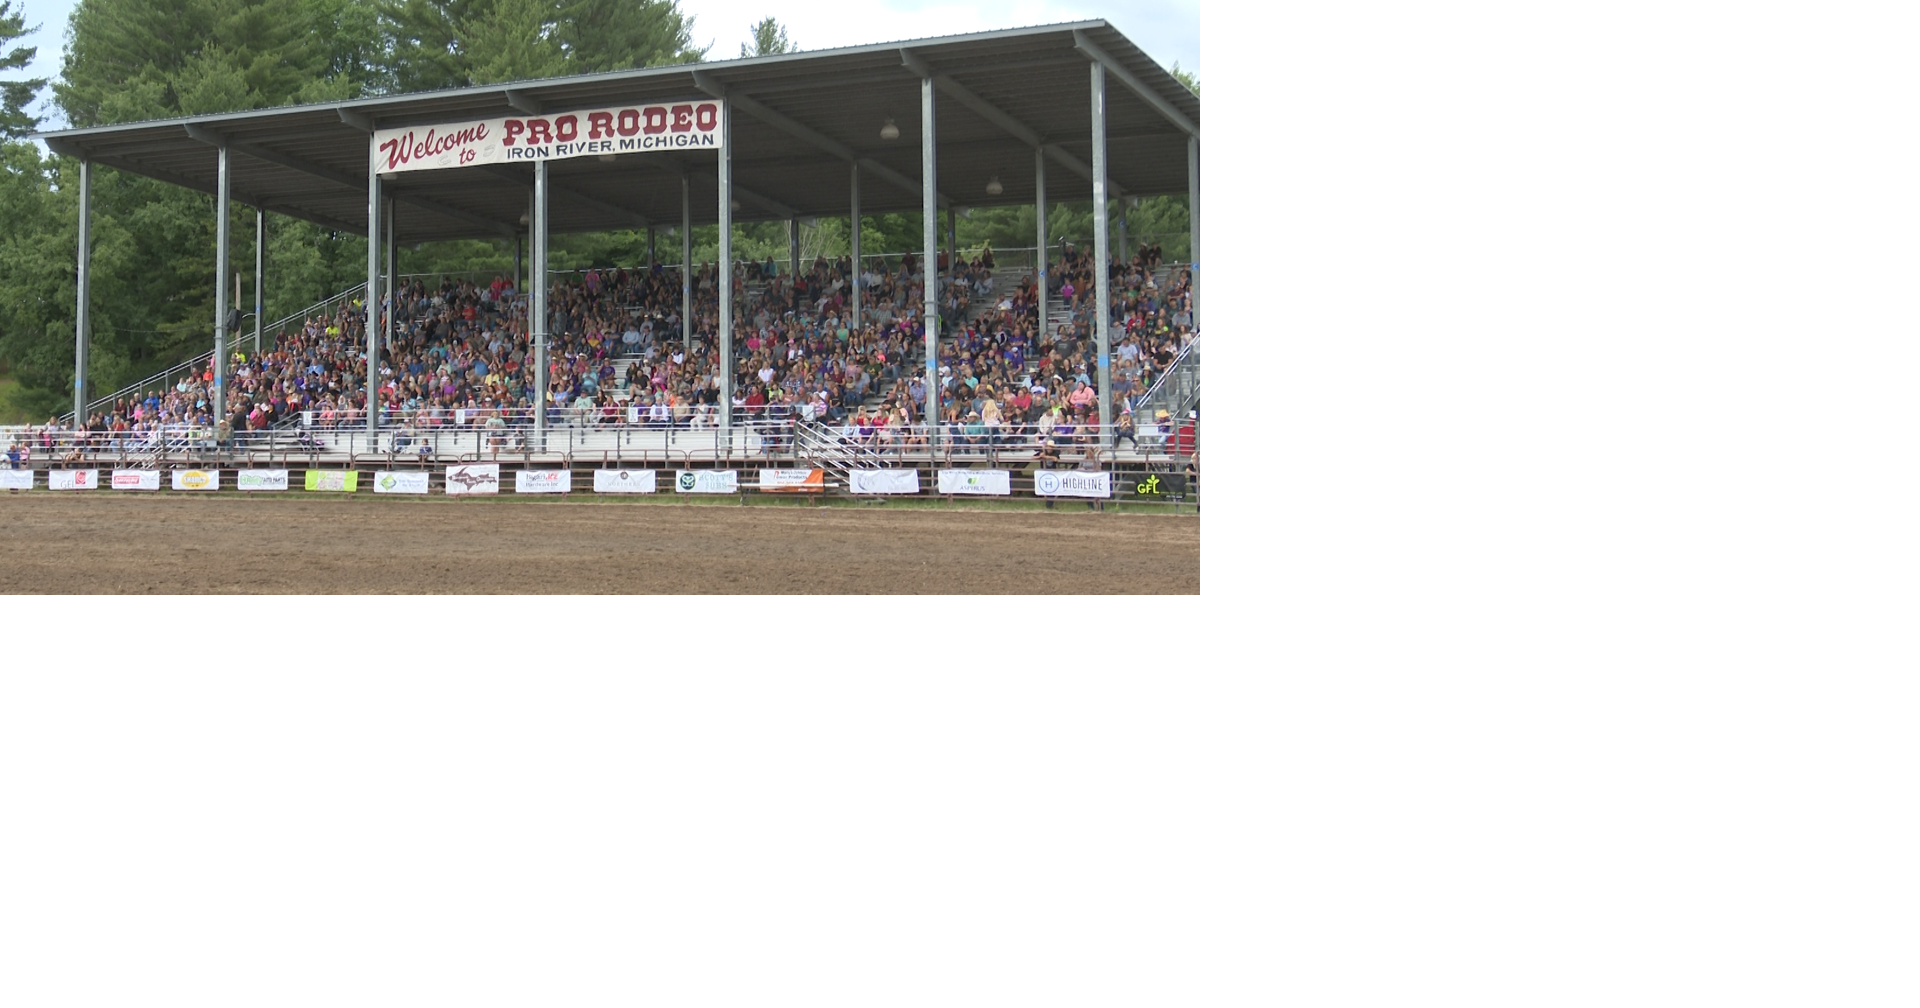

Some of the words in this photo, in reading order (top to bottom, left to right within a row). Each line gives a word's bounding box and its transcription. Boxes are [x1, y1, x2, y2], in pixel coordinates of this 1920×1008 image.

[502, 114, 578, 147] PRO
[587, 103, 718, 140] RODEO
[379, 122, 490, 170] Welcome
[459, 147, 476, 165] to
[507, 146, 549, 160] IRON
[556, 140, 615, 156] RIVER,
[620, 134, 714, 150] MICHIGAN
[1062, 477, 1103, 491] HIGHLINE
[1137, 480, 1160, 494] GFL
